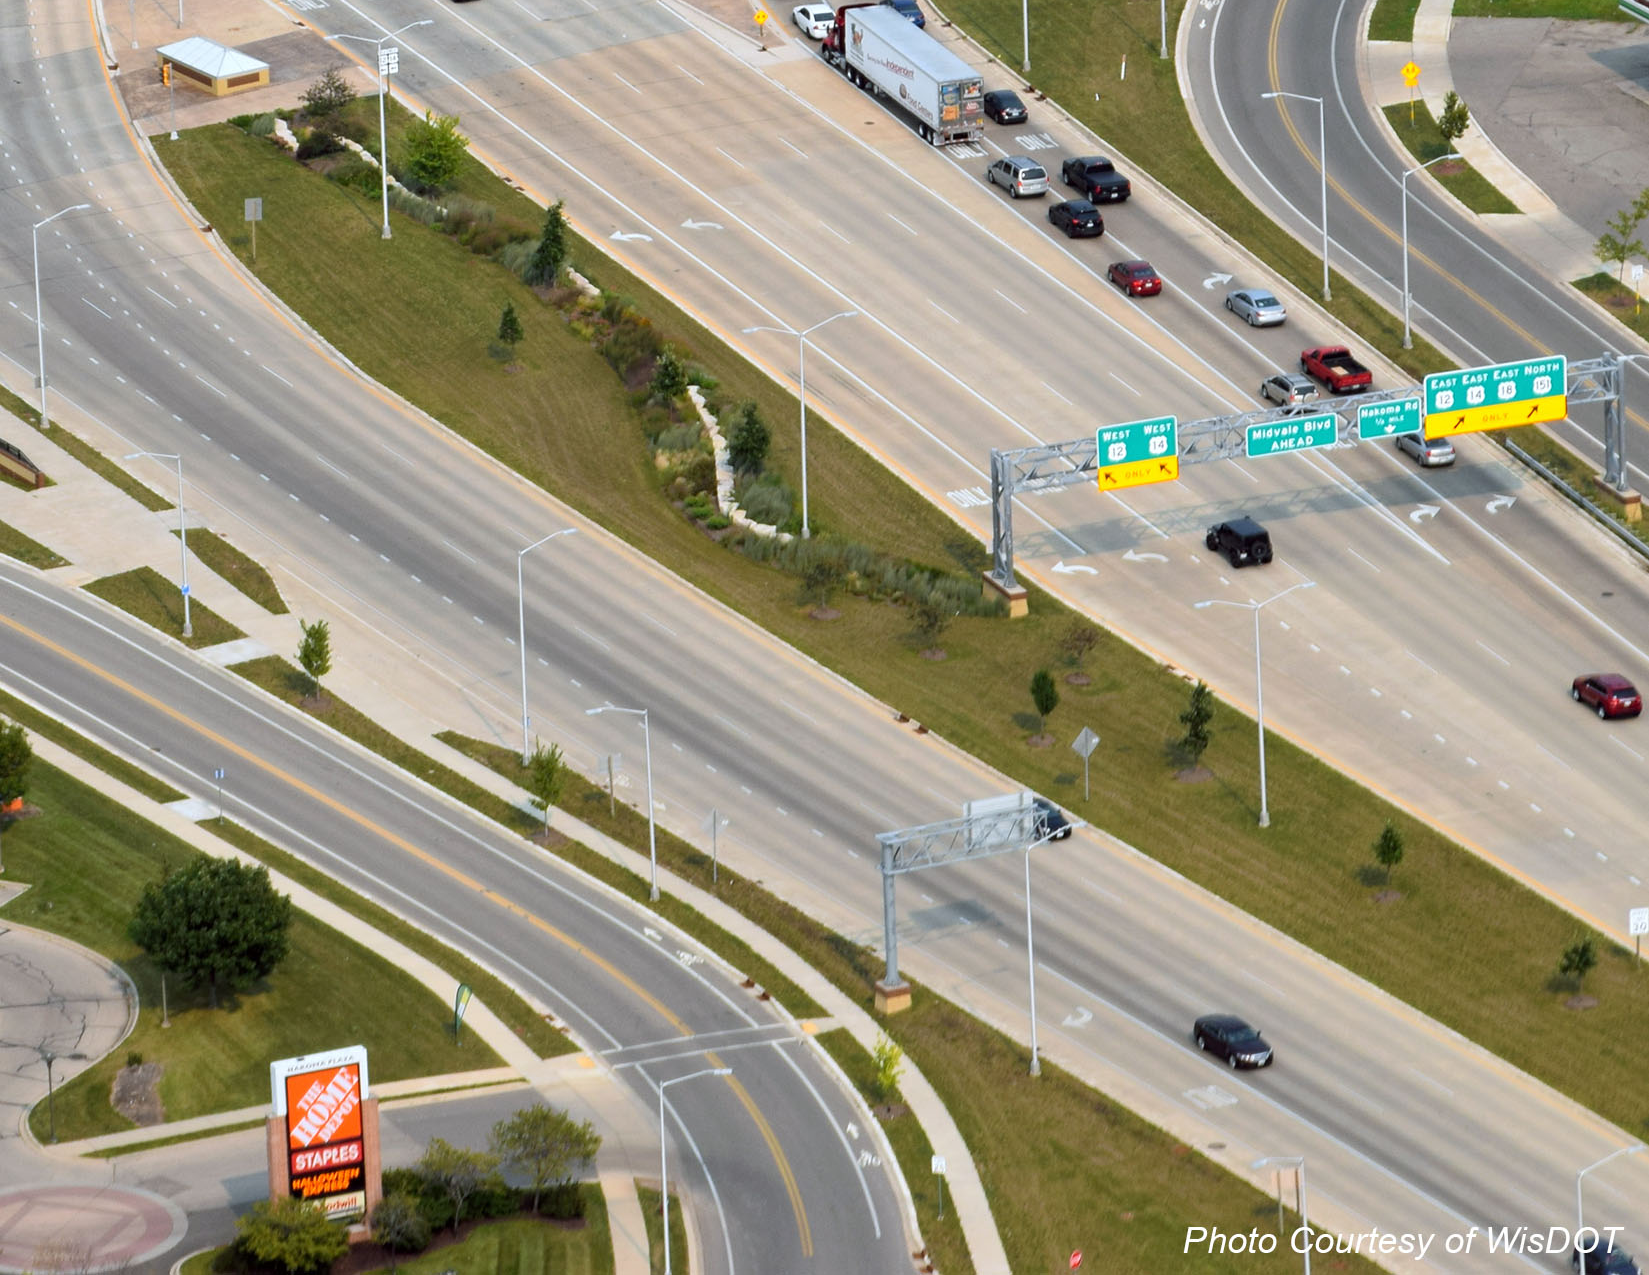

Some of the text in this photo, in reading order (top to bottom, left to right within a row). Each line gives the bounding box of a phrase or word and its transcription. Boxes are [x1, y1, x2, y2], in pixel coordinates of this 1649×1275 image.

[1431, 363, 1560, 390] EAST EAST EAST NORTH
[1439, 379, 1550, 405] 12 14 18 151
[1361, 401, 1418, 418] Nakoma Rd
[1482, 412, 1509, 422] ONLY
[1103, 423, 1171, 442] WEST WEST
[1252, 419, 1331, 440] Midvale Blvd
[1112, 440, 1164, 458] 12 14
[1271, 436, 1314, 451] AHEAD
[290, 1066, 359, 1147] HOME
[297, 1080, 325, 1112] THE
[318, 1094, 360, 1143] DEPOT
[295, 1144, 359, 1170] STAPLES
